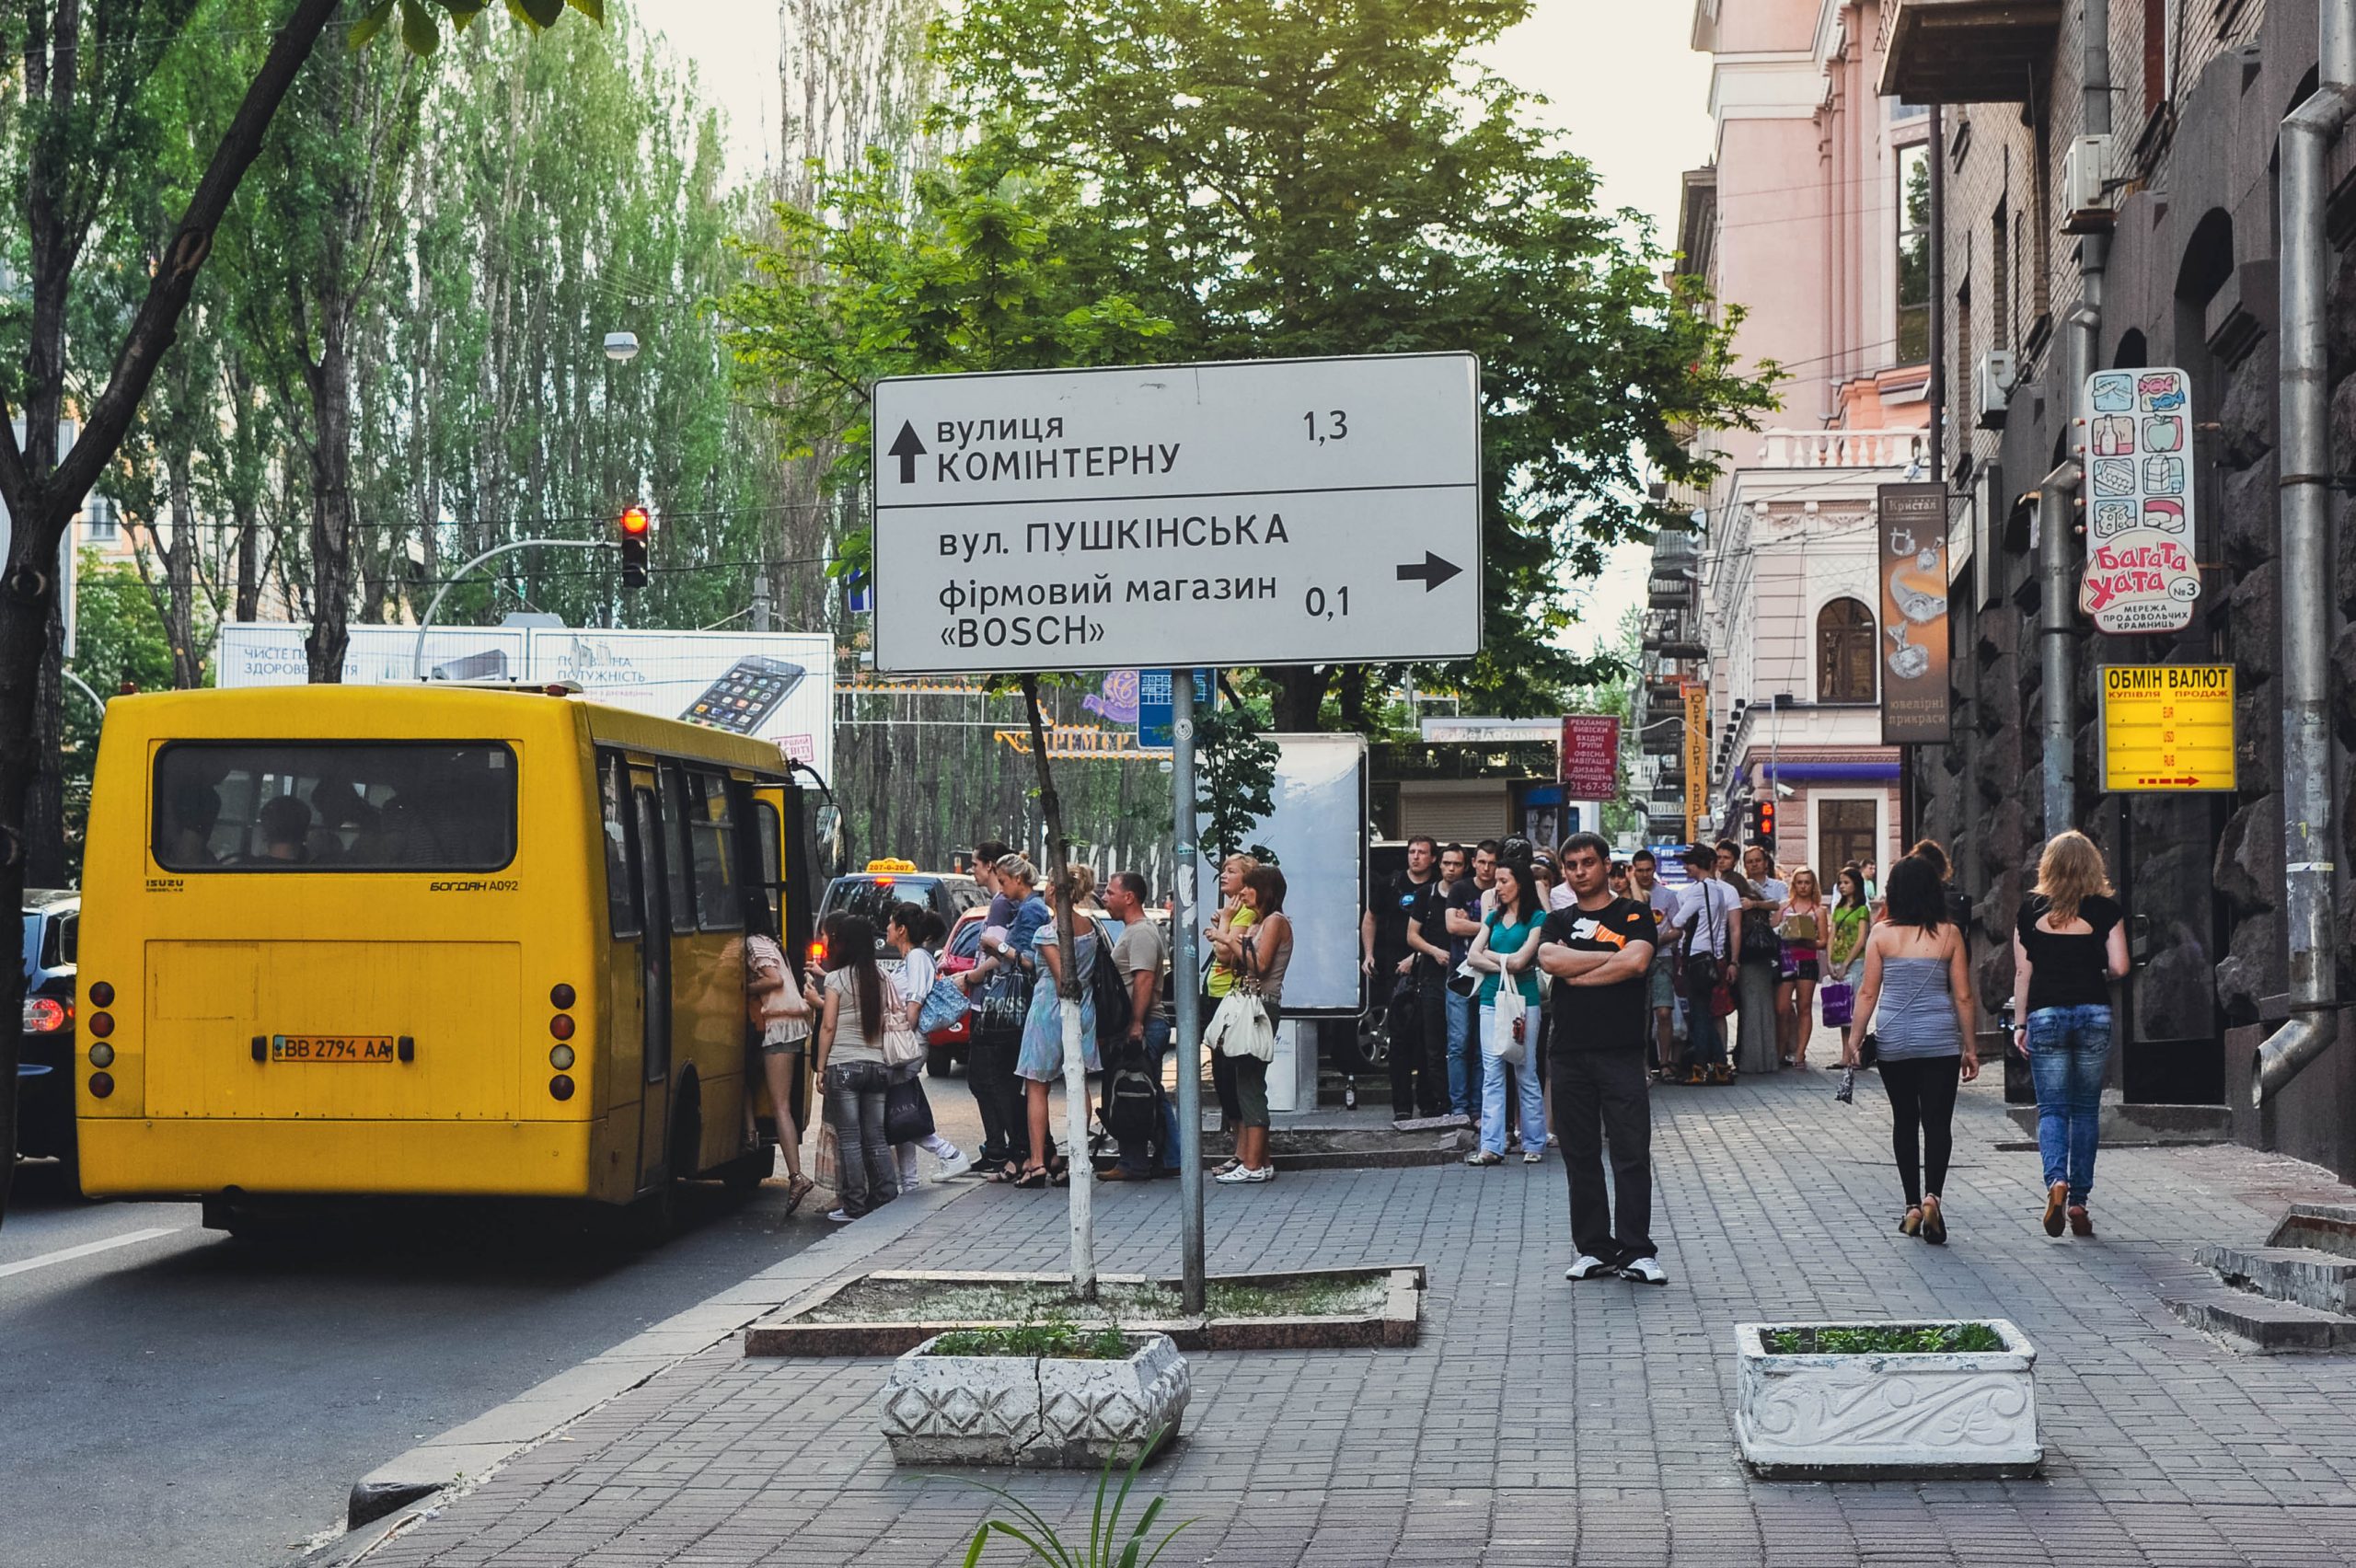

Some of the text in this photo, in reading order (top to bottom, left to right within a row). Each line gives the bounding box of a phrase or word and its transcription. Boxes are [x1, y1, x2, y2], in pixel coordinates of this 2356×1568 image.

[937, 417, 1063, 451] вулиця
[1303, 410, 1348, 446] 1,3
[938, 443, 1181, 483] КОМІНТЕРНУ
[1888, 500, 1937, 513] Кристал
[940, 513, 1289, 563] вул. ПУШКІНСЬКА
[2096, 541, 2187, 572] Багата
[939, 572, 1276, 616] фірмовий магазин
[1305, 586, 1349, 621] 0,1
[2103, 611, 2189, 623] ПРОДОВОЛЬЧИХ
[2123, 604, 2167, 613] МЕРЕЖА
[941, 615, 1104, 648] «BOSCH»
[2117, 620, 2175, 630] КРАМНИЦЬ
[244, 648, 288, 660] ЧИСТЕ
[2108, 668, 2228, 689] ОБМІН ВАЛЮТ
[1888, 714, 1946, 727] прикраси
[430, 882, 487, 891] БОГДАН
[316, 1040, 355, 1057] 2794
